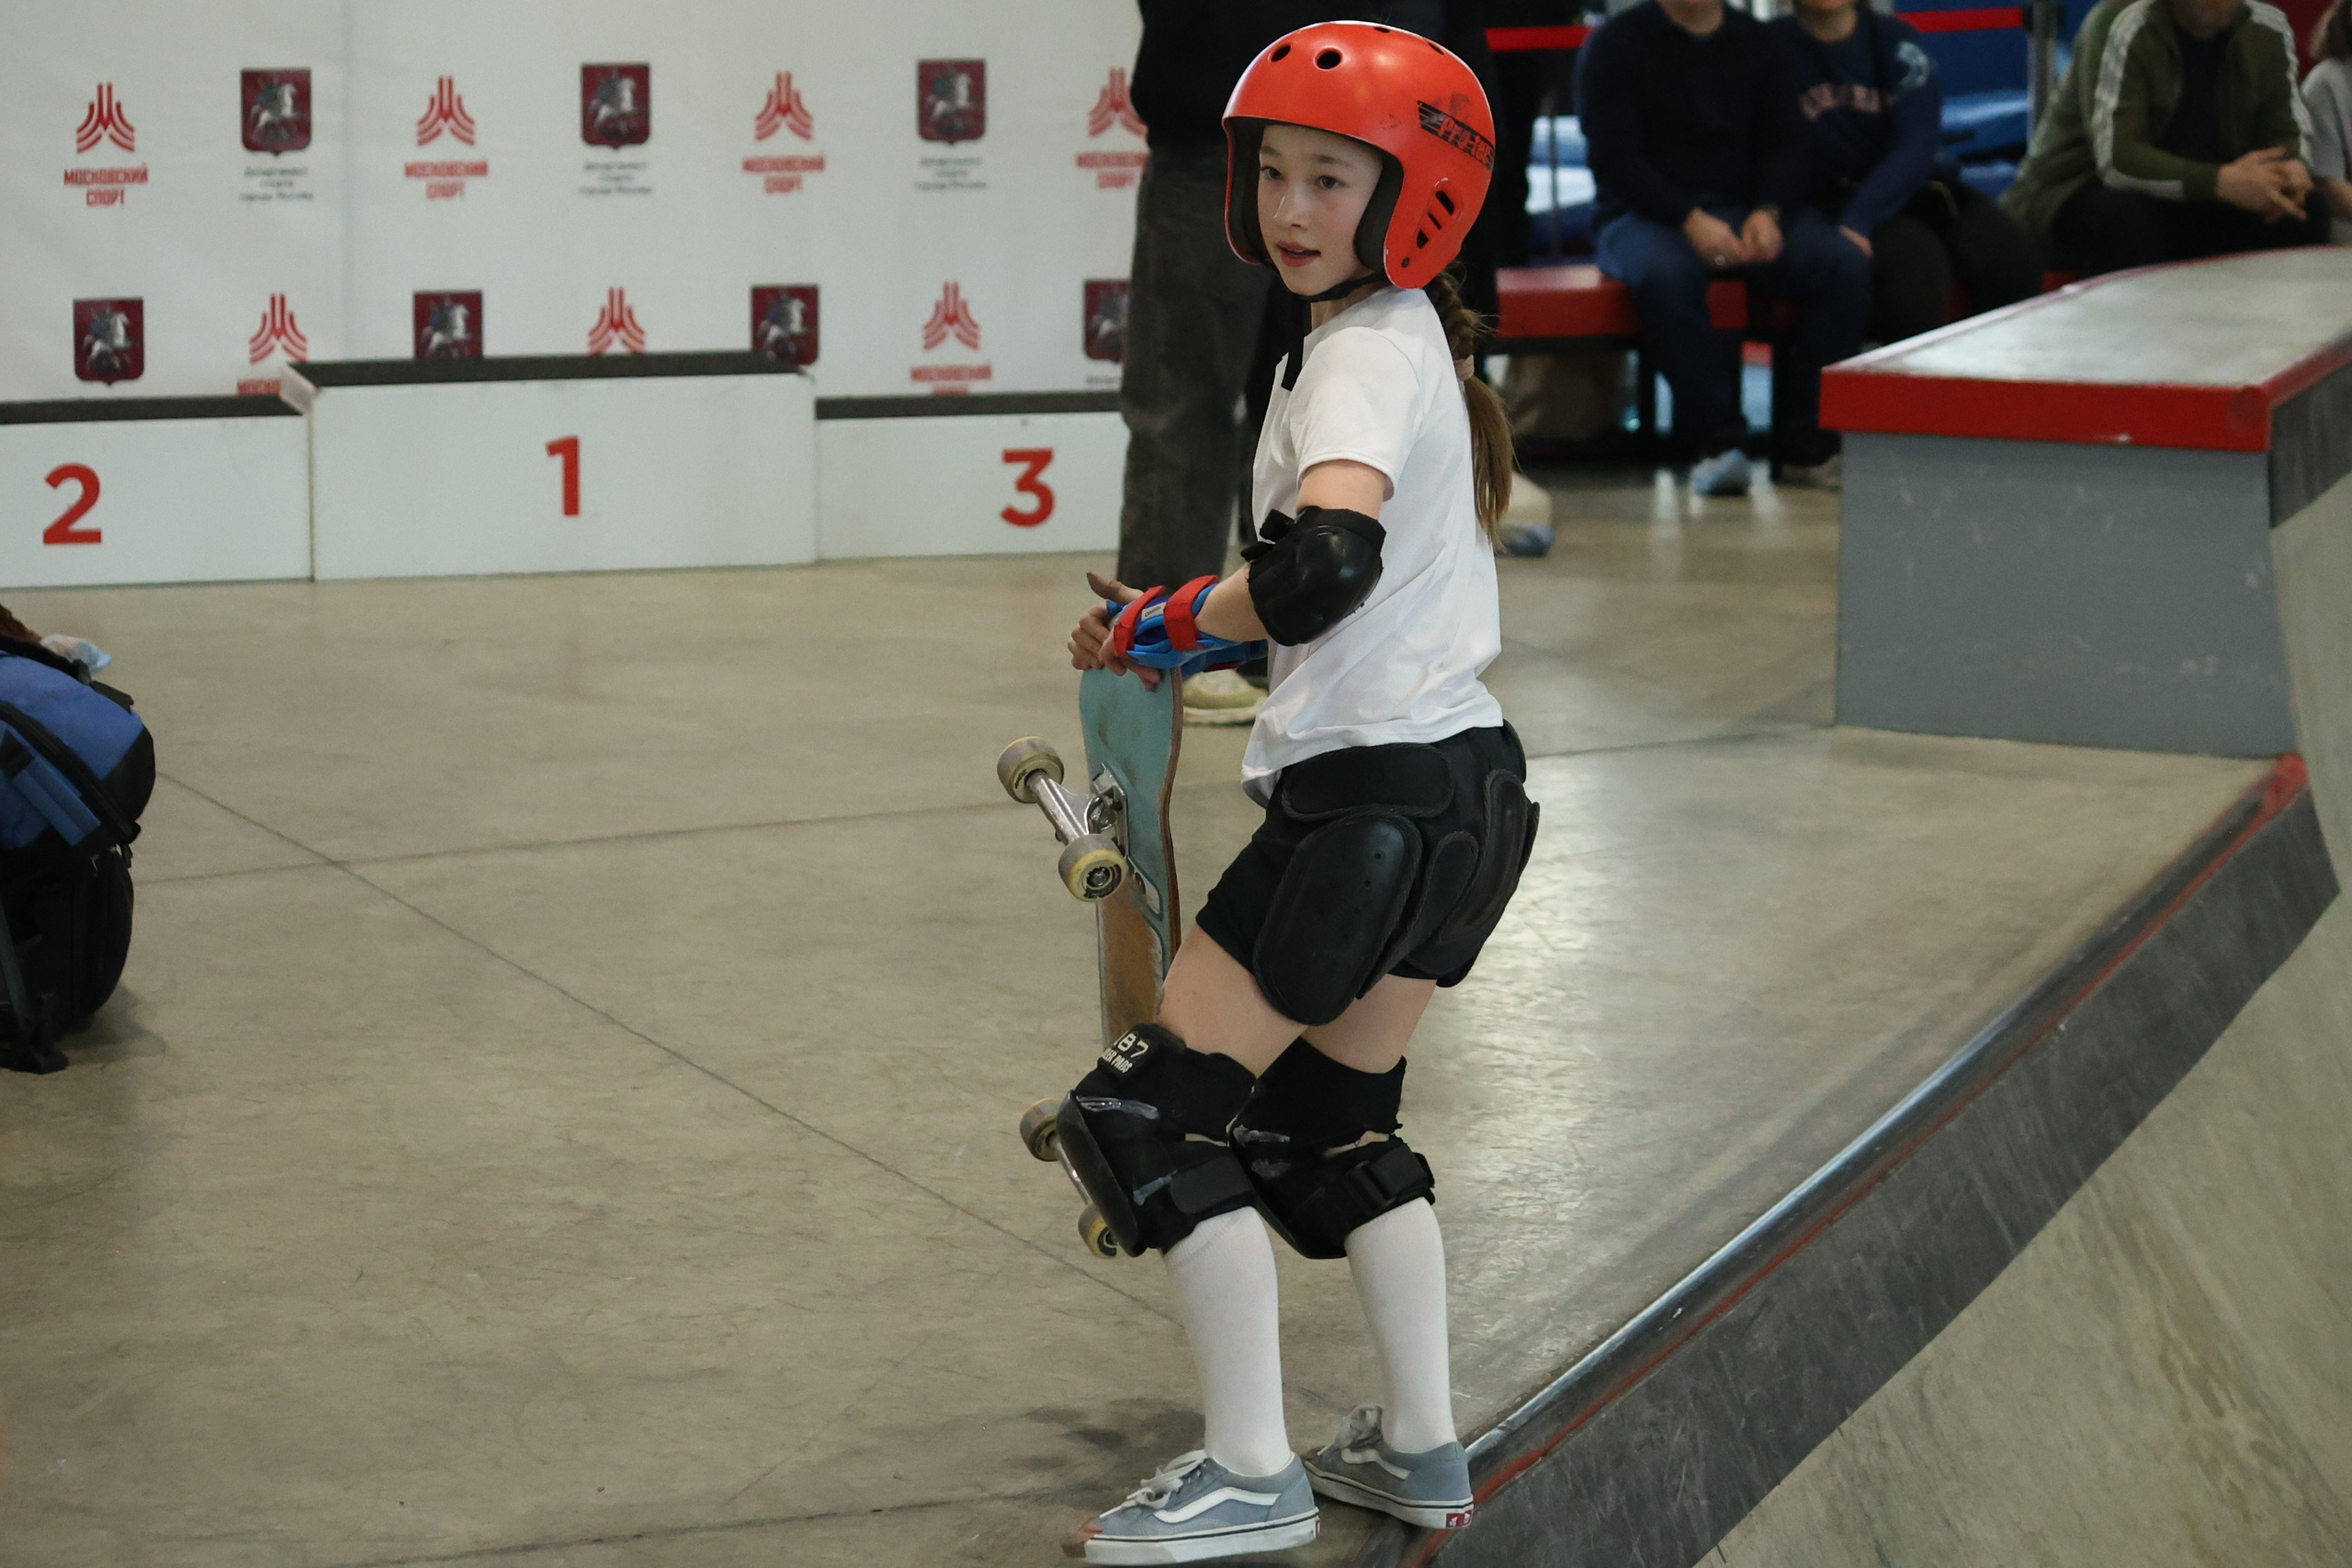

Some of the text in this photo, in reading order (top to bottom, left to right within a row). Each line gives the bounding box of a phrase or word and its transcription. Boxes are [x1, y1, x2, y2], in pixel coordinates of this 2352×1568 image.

[86, 189, 125, 206] СПОРТ
[42, 462, 102, 545] 2
[545, 435, 580, 516] 1
[1001, 447, 1056, 526] 3
